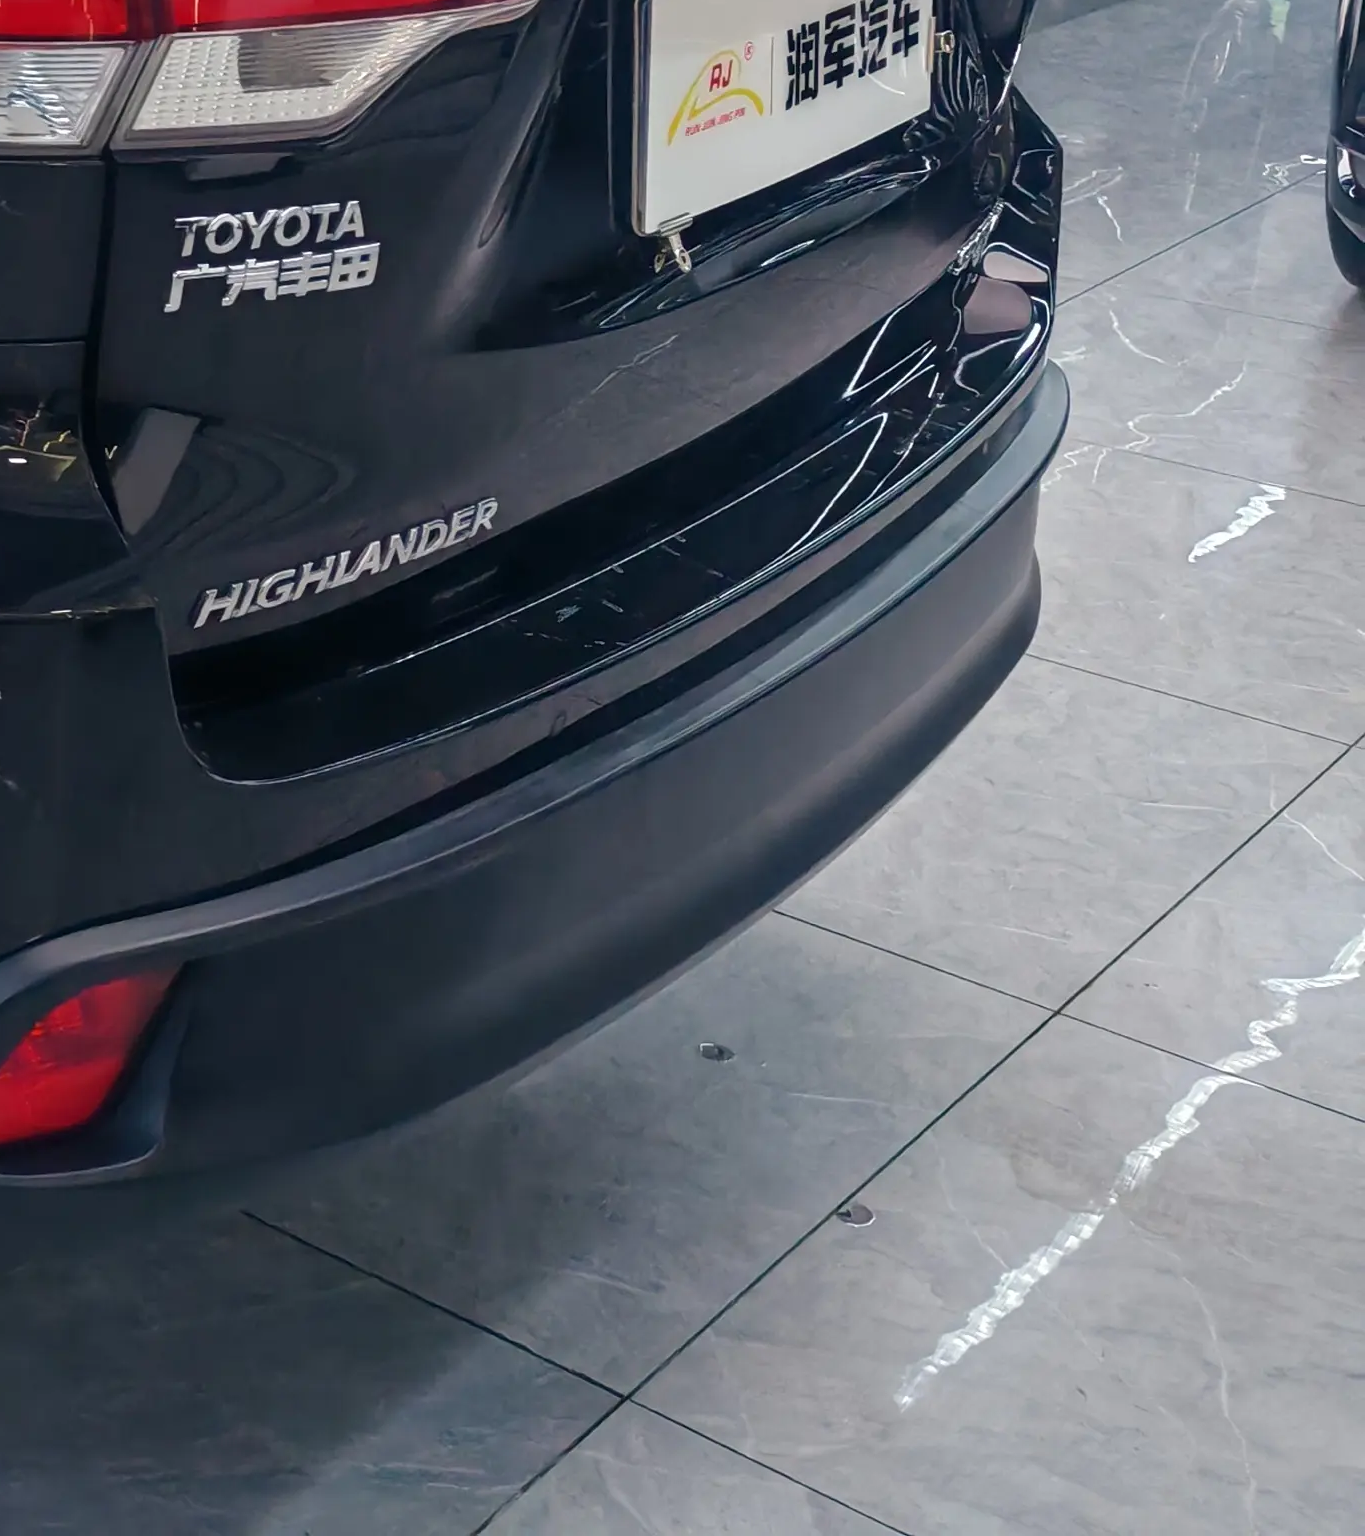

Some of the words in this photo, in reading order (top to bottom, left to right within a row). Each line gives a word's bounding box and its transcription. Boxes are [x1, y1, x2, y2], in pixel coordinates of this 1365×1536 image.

[175, 201, 365, 256] TOYOTA
[164, 243, 380, 313] 广汽丰田
[193, 497, 499, 629] HIGHLANDER
